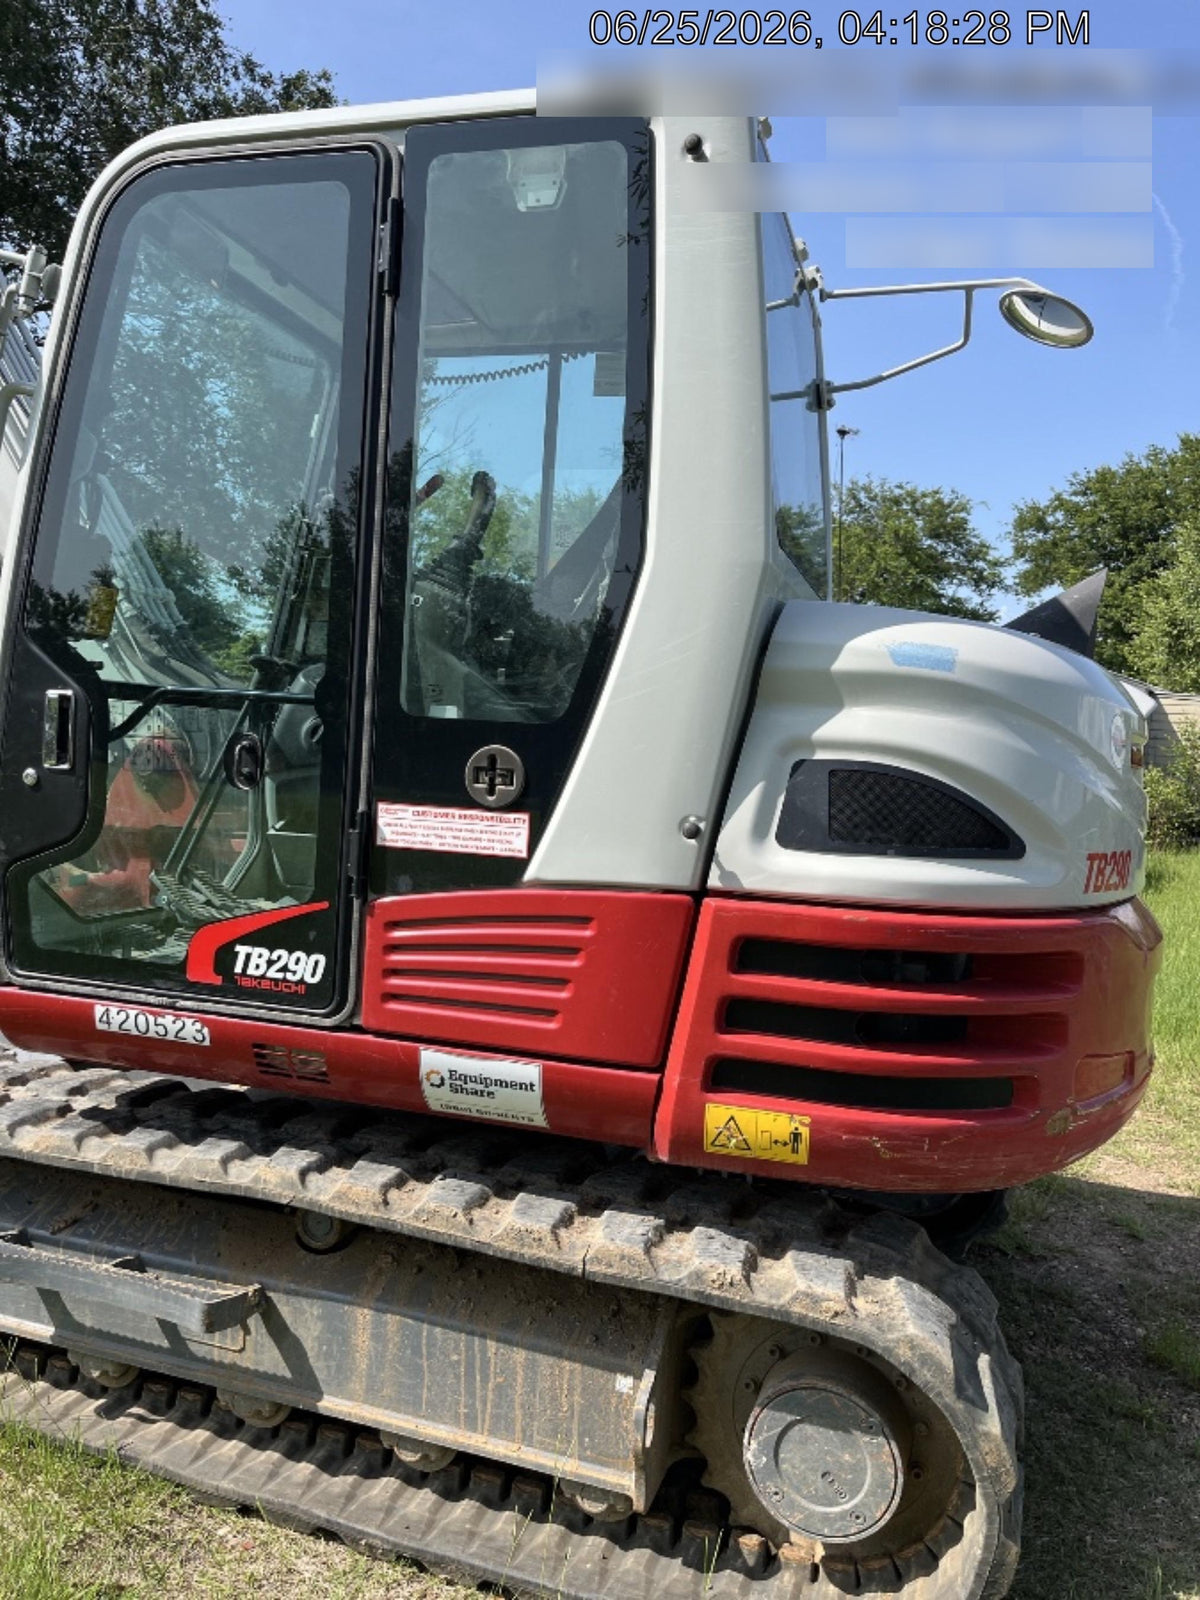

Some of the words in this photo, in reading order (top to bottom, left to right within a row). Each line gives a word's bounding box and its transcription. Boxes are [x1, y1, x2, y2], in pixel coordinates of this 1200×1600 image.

[1083, 850, 1131, 894] TB290
[233, 944, 327, 985] TB290
[98, 1007, 207, 1044] 420523
[448, 1069, 536, 1092] Equipment
[449, 1082, 495, 1099] Share
